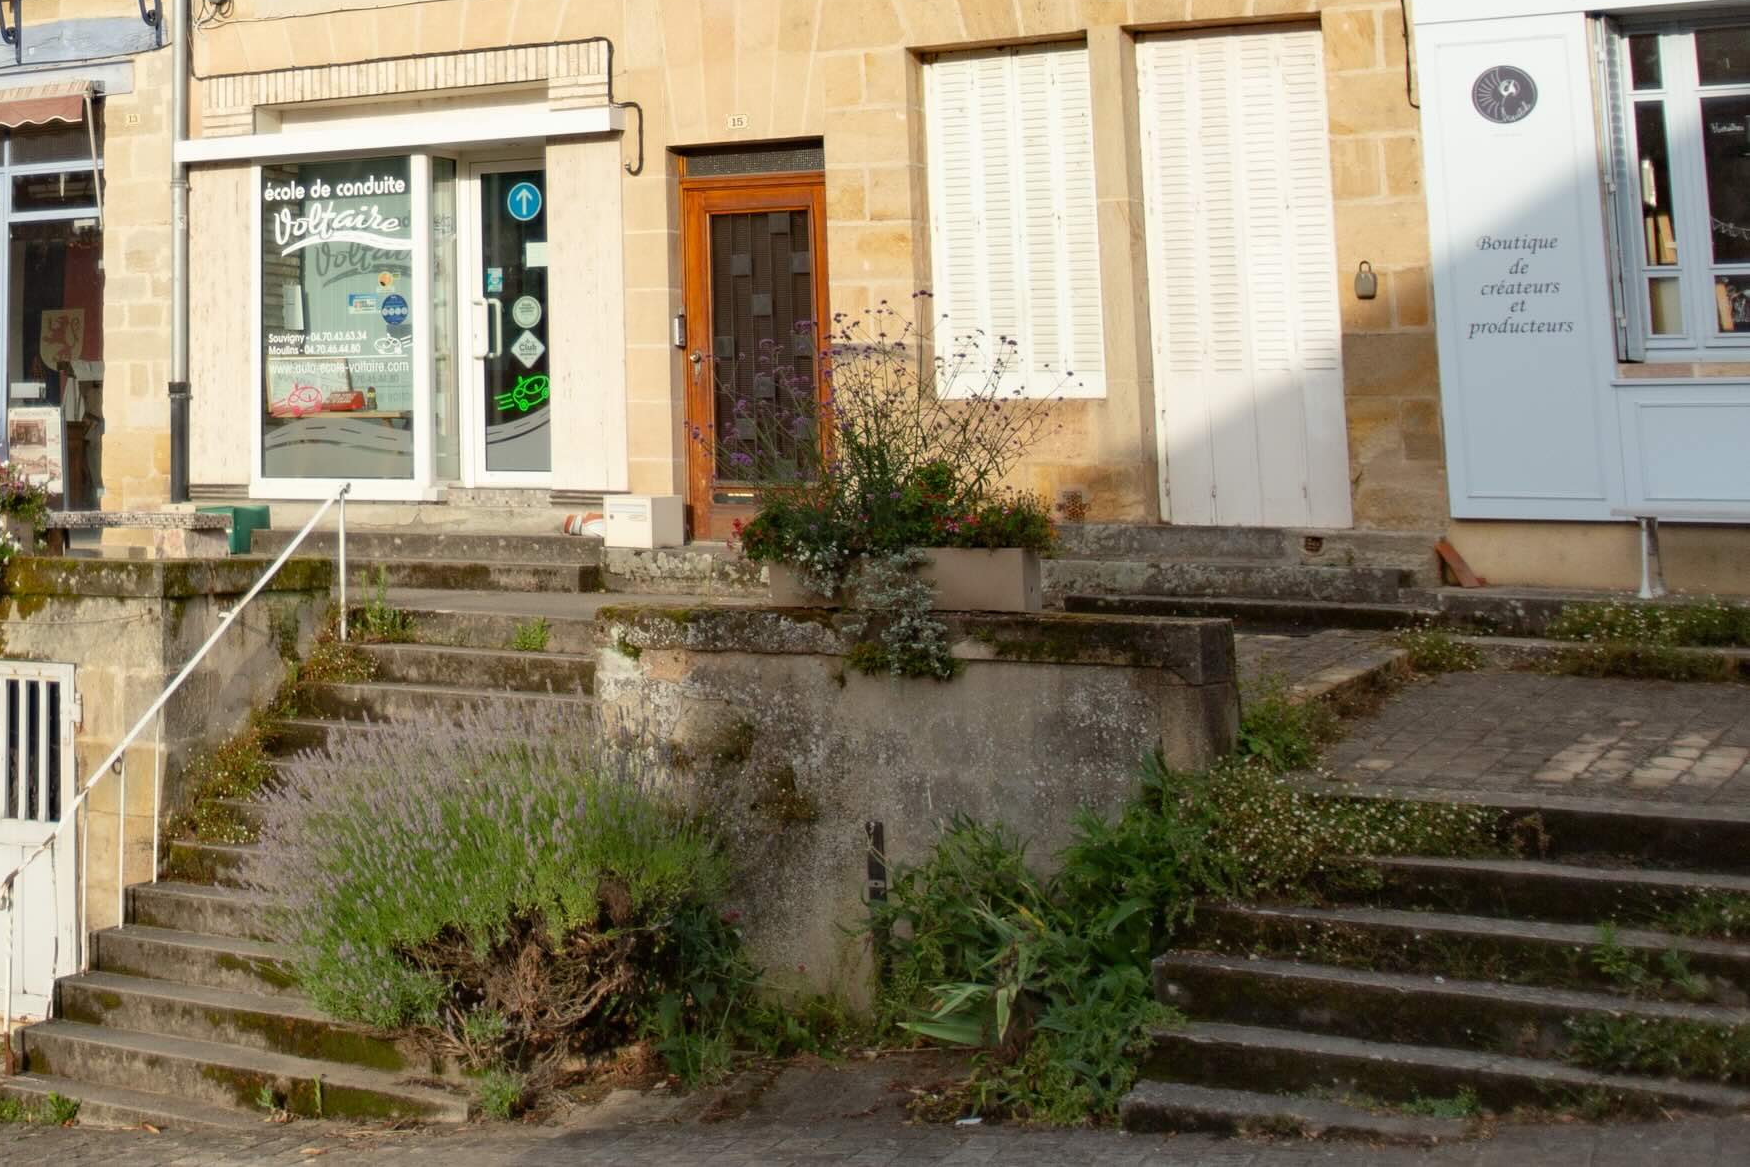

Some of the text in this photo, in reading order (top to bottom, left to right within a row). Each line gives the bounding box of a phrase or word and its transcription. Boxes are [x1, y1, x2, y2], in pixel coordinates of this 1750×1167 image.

[732, 117, 743, 127] 15
[264, 175, 406, 201] école de conduite
[273, 201, 401, 246] Voltaire
[1476, 234, 1558, 254] Boutique
[1509, 258, 1529, 276] de
[1480, 280, 1561, 296] créateurs
[1510, 299, 1527, 314] et
[1468, 316, 1574, 340] producteurs
[268, 333, 305, 345] Souvigny
[268, 345, 300, 355] Moulins
